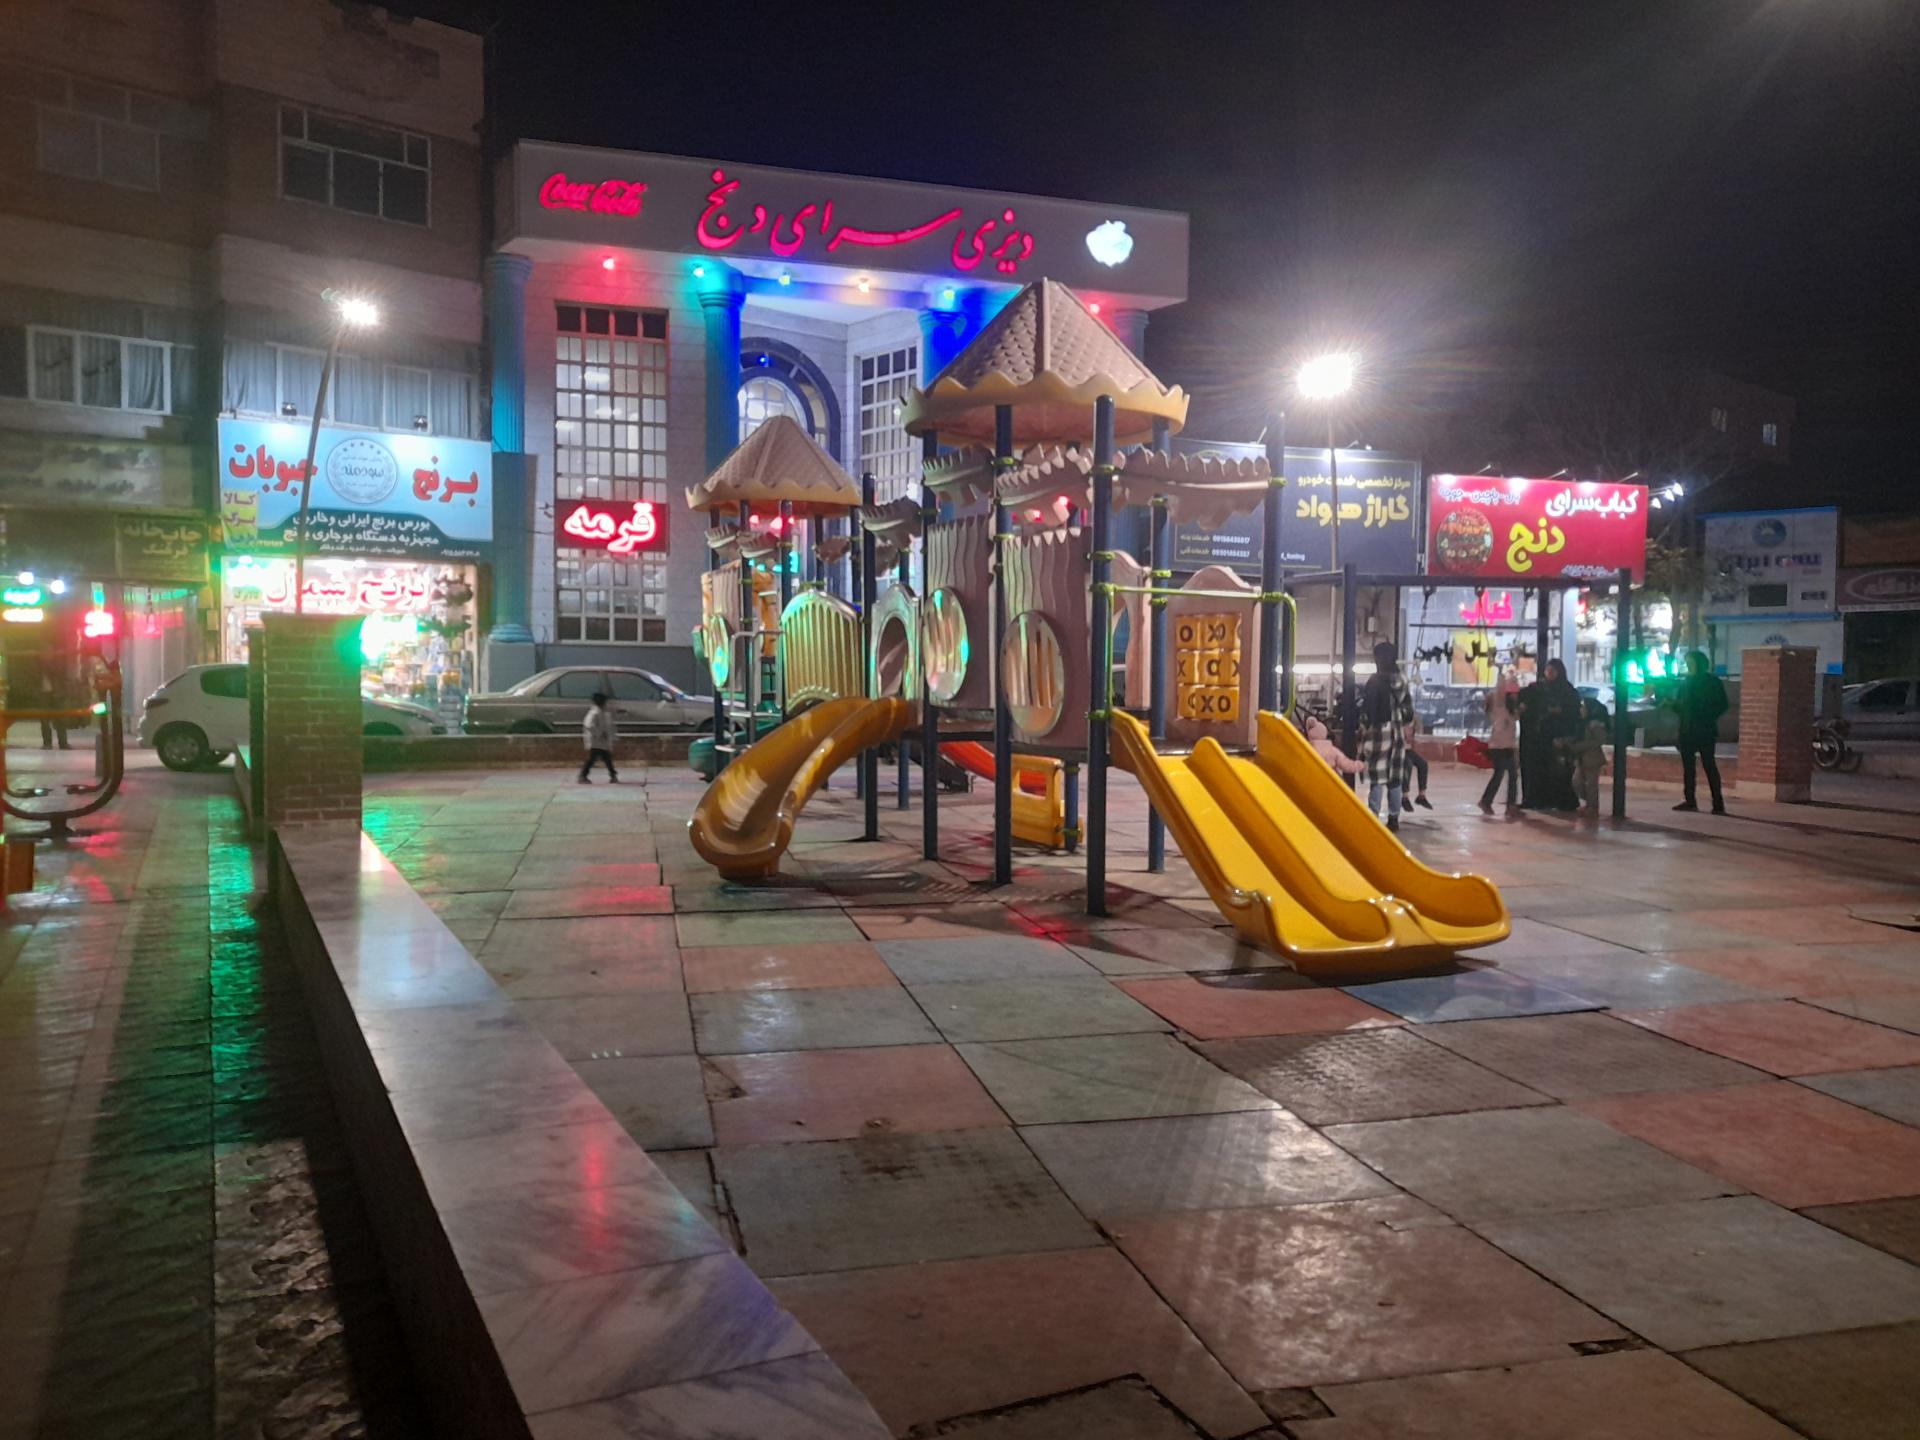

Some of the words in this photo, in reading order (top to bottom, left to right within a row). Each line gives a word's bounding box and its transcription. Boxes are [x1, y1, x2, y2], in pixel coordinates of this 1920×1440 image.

[697, 167, 768, 251] دنج
[770, 199, 964, 258] سرای
[950, 208, 1034, 274] دیزی
[228, 443, 319, 498] حبوبات
[411, 456, 480, 508] برنج
[1297, 473, 1324, 488] خودرو
[1325, 474, 1357, 487] خدمت
[1356, 476, 1393, 490] تخصصی
[1393, 476, 1412, 490] مرکز
[1364, 493, 1411, 529] گاراژ
[1545, 487, 1594, 517] سرای
[1593, 488, 1640, 520] کباب
[337, 512, 371, 528] ایرانی
[371, 515, 397, 531] برنج
[398, 519, 431, 533] بورس
[564, 502, 656, 553] قرمه
[283, 527, 311, 543] بنج
[312, 526, 353, 545] بوجاری
[355, 528, 398, 543] دستگاه
[1506, 517, 1567, 575] دنج
